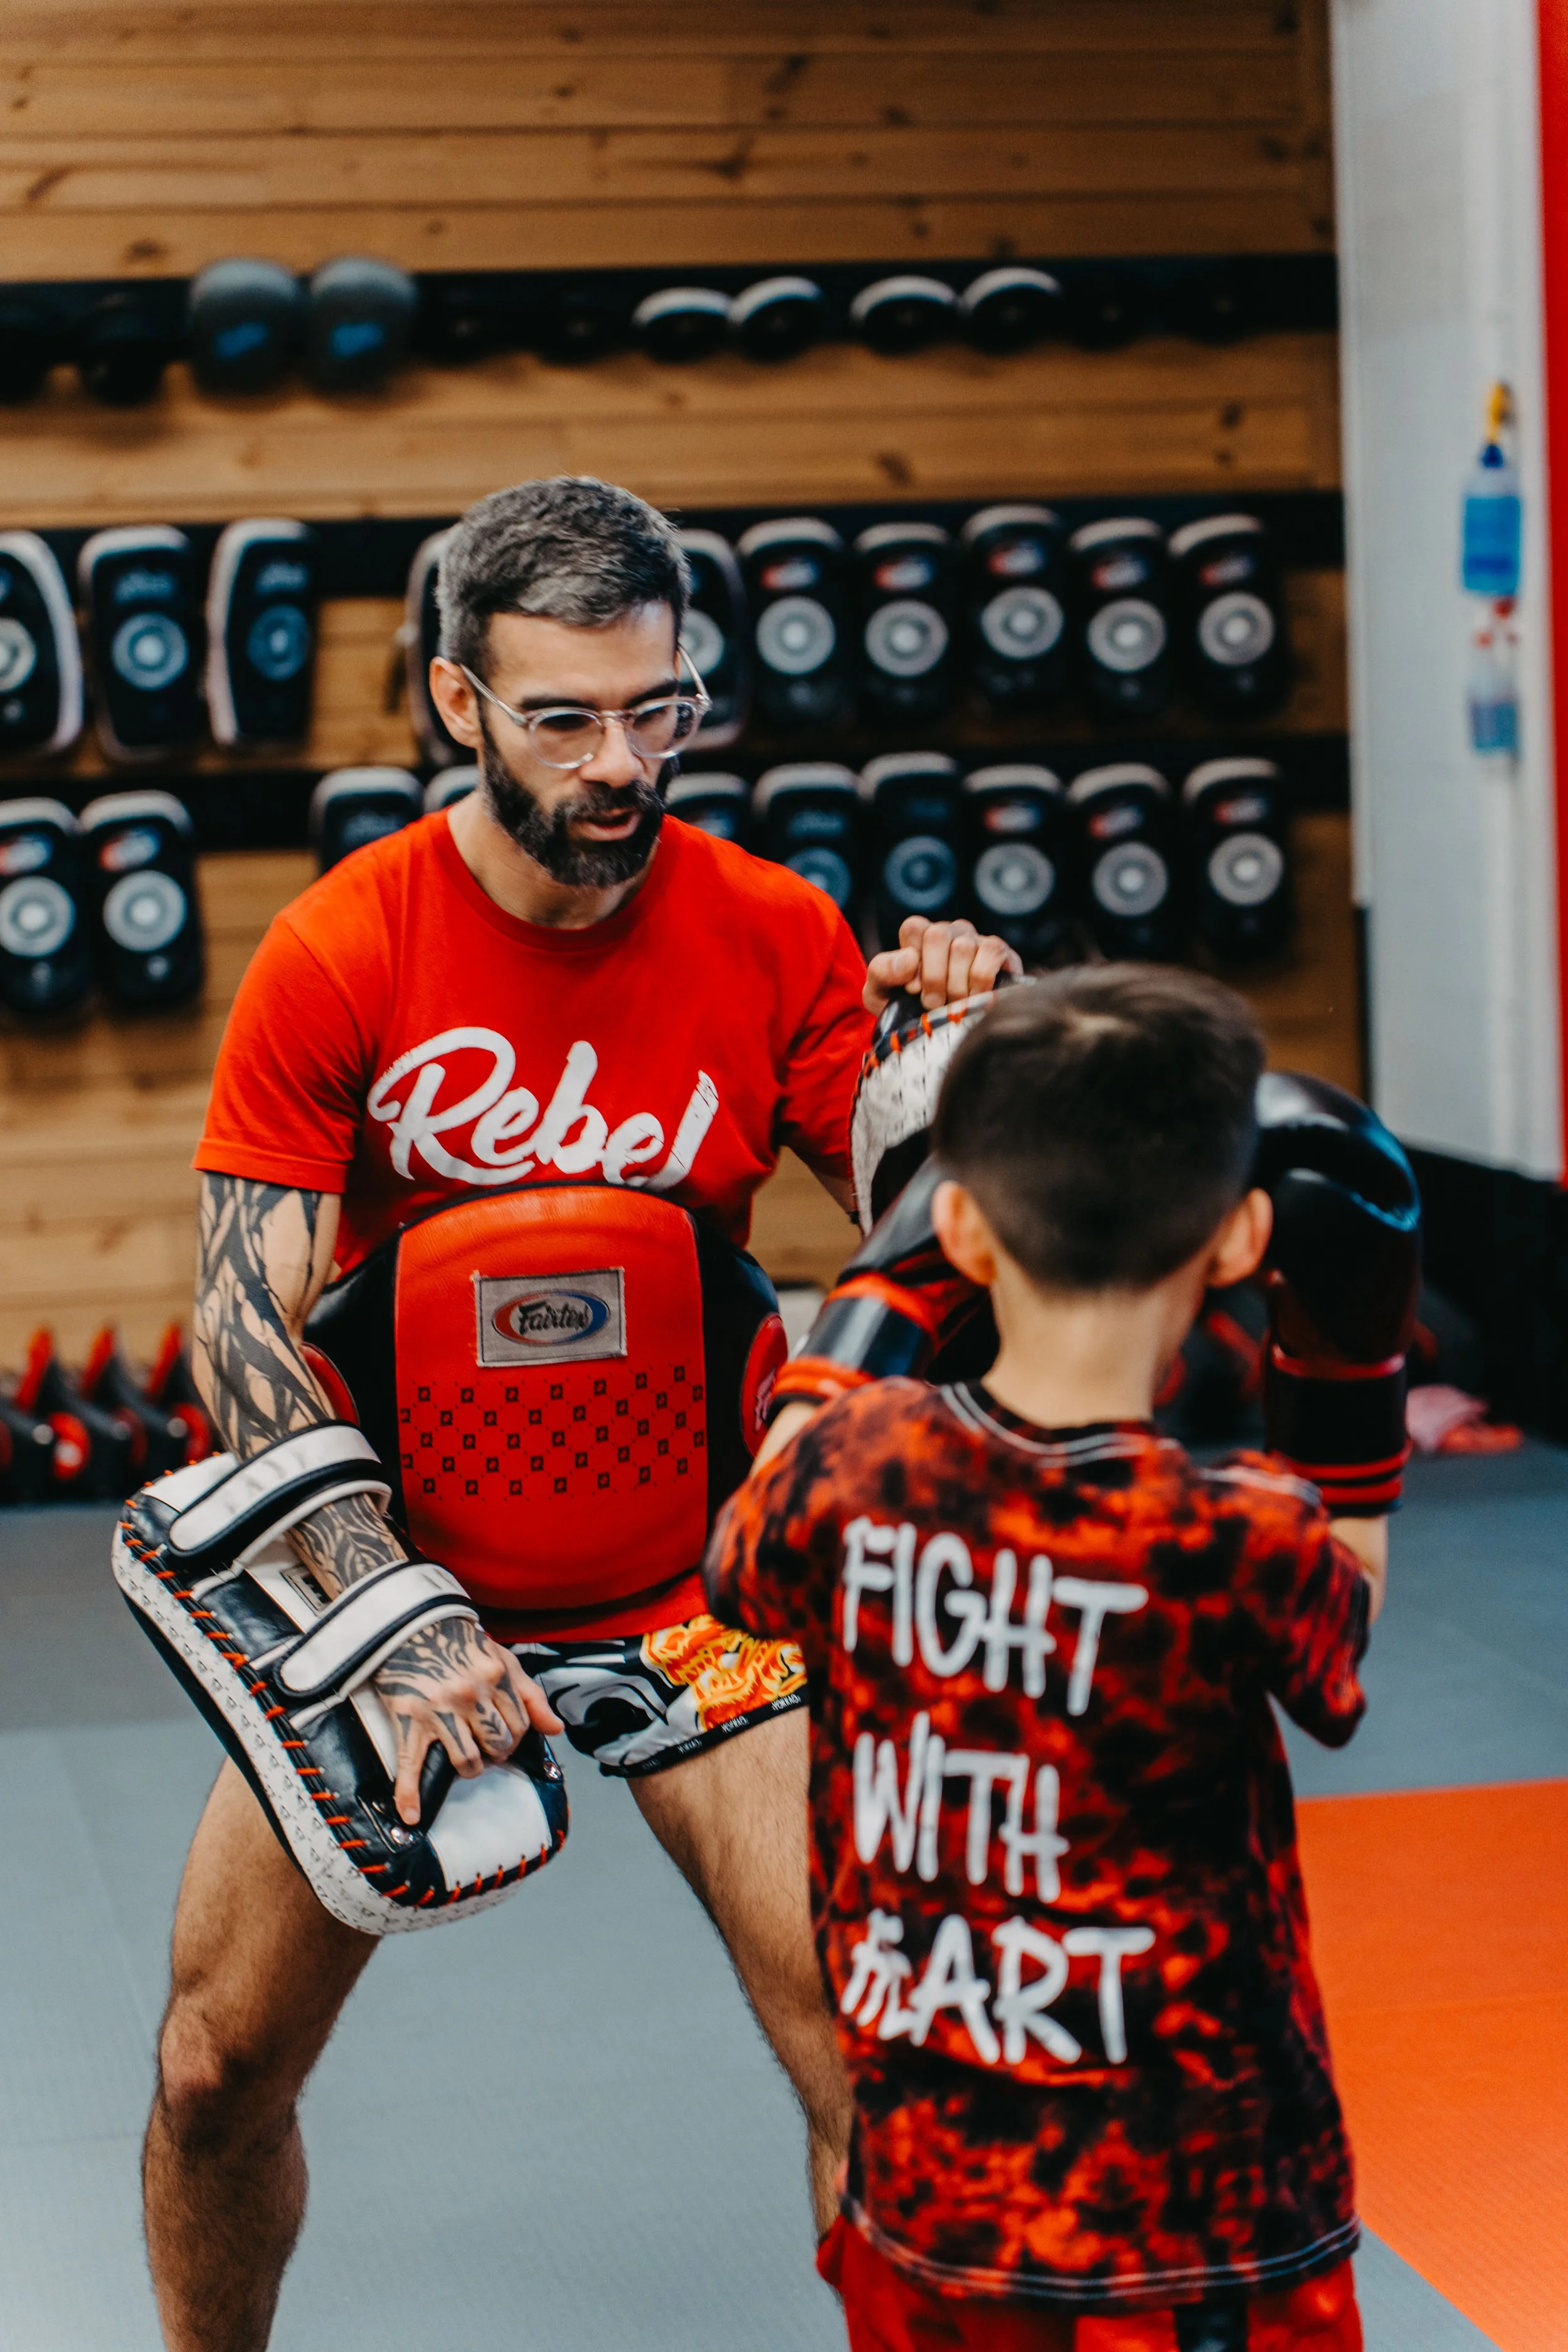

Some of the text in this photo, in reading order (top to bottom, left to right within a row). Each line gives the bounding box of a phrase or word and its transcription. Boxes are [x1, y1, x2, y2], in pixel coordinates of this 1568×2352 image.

[368, 1026, 719, 1190] Rebel
[518, 1299, 590, 1336] Fairtex
[844, 1515, 1149, 1716] FIGHT
[853, 1710, 1070, 1904] WITH
